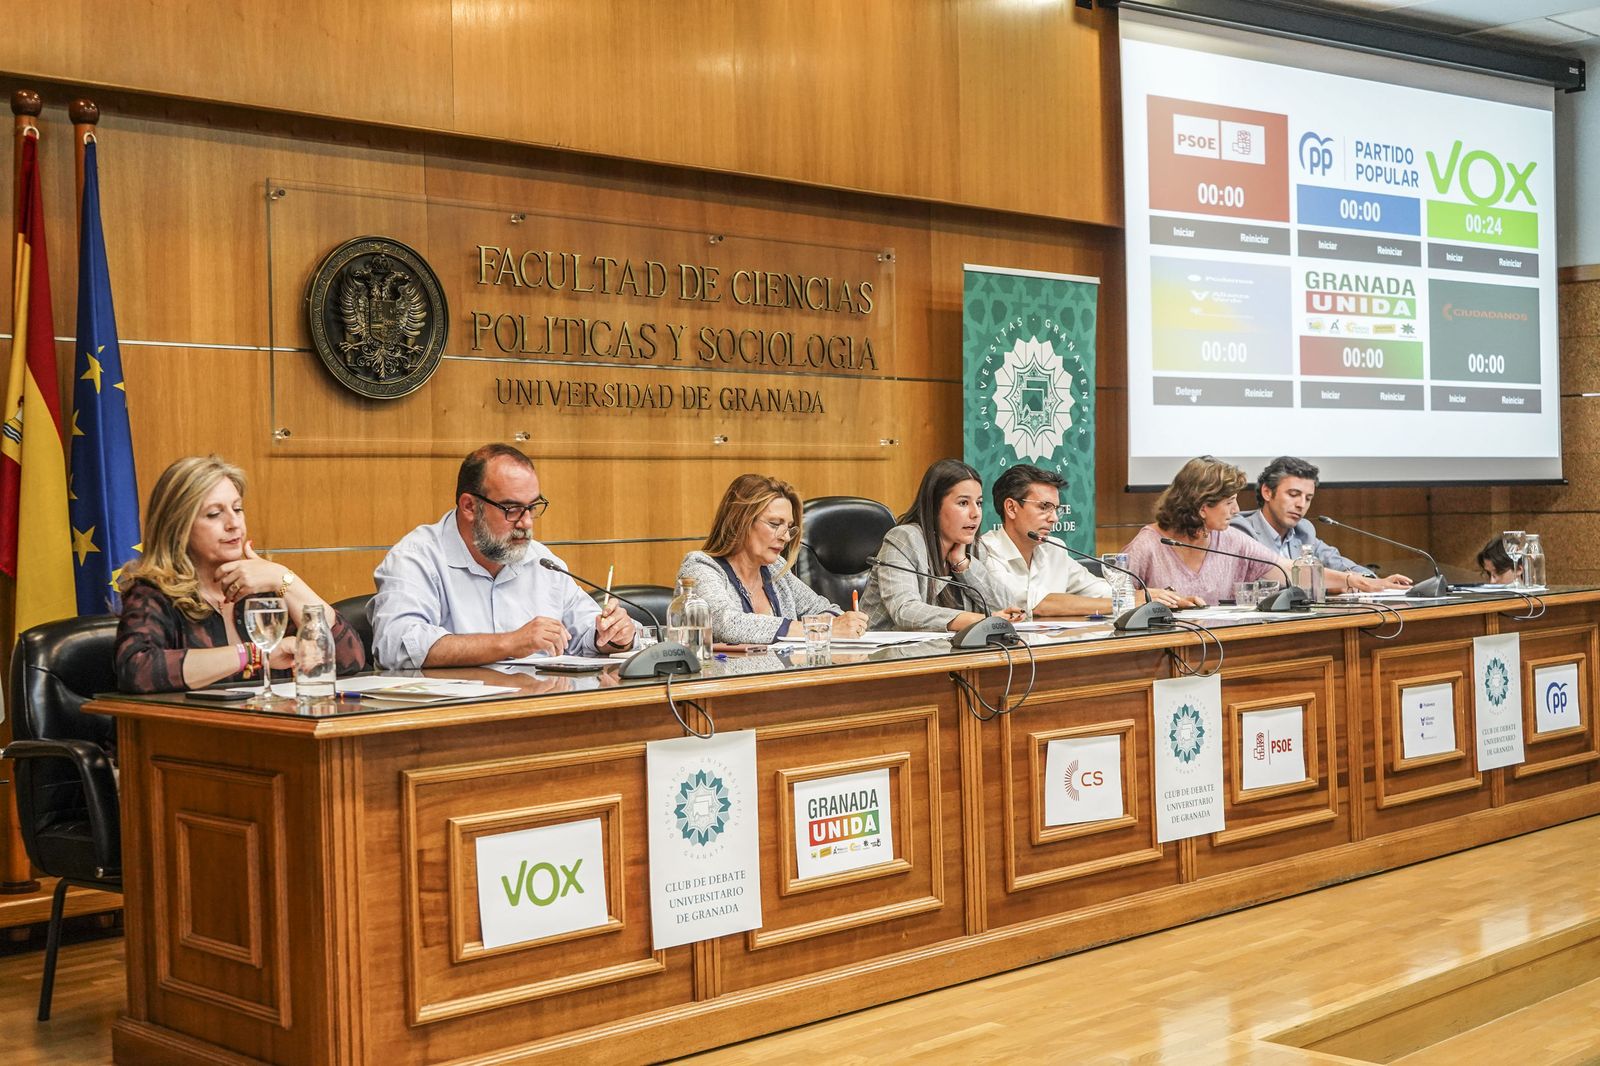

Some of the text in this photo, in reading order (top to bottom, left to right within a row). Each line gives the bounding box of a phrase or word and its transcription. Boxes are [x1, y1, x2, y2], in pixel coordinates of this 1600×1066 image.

[1177, 133, 1217, 150] PSOE
[1355, 140, 1414, 165] PARTIDO
[1356, 163, 1419, 188] POPULAR
[1425, 139, 1538, 207] VOX
[1198, 182, 1245, 208] 00:00
[1340, 198, 1381, 222] 00:00
[1172, 226, 1196, 238] Iniciar
[1465, 213, 1503, 235] 00:24
[1240, 233, 1269, 244] Reiniciar
[1318, 240, 1338, 250] Iniciar
[1377, 245, 1403, 257] Reiniciar
[1446, 252, 1464, 262] Iniciar
[1498, 257, 1522, 268] Reiniciar
[477, 245, 875, 315] FACULTAD DE CIENCIAS
[1305, 270, 1416, 297] GRANADA
[1312, 294, 1412, 316] UNIDA
[471, 311, 879, 370] POLITICAS Y SOCIOLOGIA
[1201, 341, 1247, 363] 00:00
[1342, 347, 1384, 369] 00:00
[1468, 353, 1505, 374] 00:00
[980, 317, 1089, 435] UNIVERSITAS GRANATENSIS
[496, 377, 825, 414] UNIVERSIDAD DE GRANADA
[1244, 388, 1274, 398] Reiniciar
[1321, 390, 1340, 400] Iniciar
[1380, 391, 1406, 402] Reiniciar
[1449, 393, 1466, 403] Iniciar
[1501, 395, 1525, 405] Reiniciar
[1063, 521, 1076, 532] DE
[663, 648, 686, 657] BOSCH
[1271, 738, 1292, 754] PSOE
[1081, 770, 1104, 787] CS
[1164, 784, 1215, 799] CLUB DE DEBATE
[808, 788, 879, 820] GRANADA
[1166, 796, 1214, 811] UNIVERSITARIO
[1171, 810, 1211, 824] DE GRANADA
[812, 814, 877, 842] UNIDA
[501, 858, 585, 907] VOX
[665, 870, 746, 893] CLUB DE DEBATE
[669, 886, 744, 909] UNIVERSITARIO
[676, 903, 740, 924] DE GRANADA
